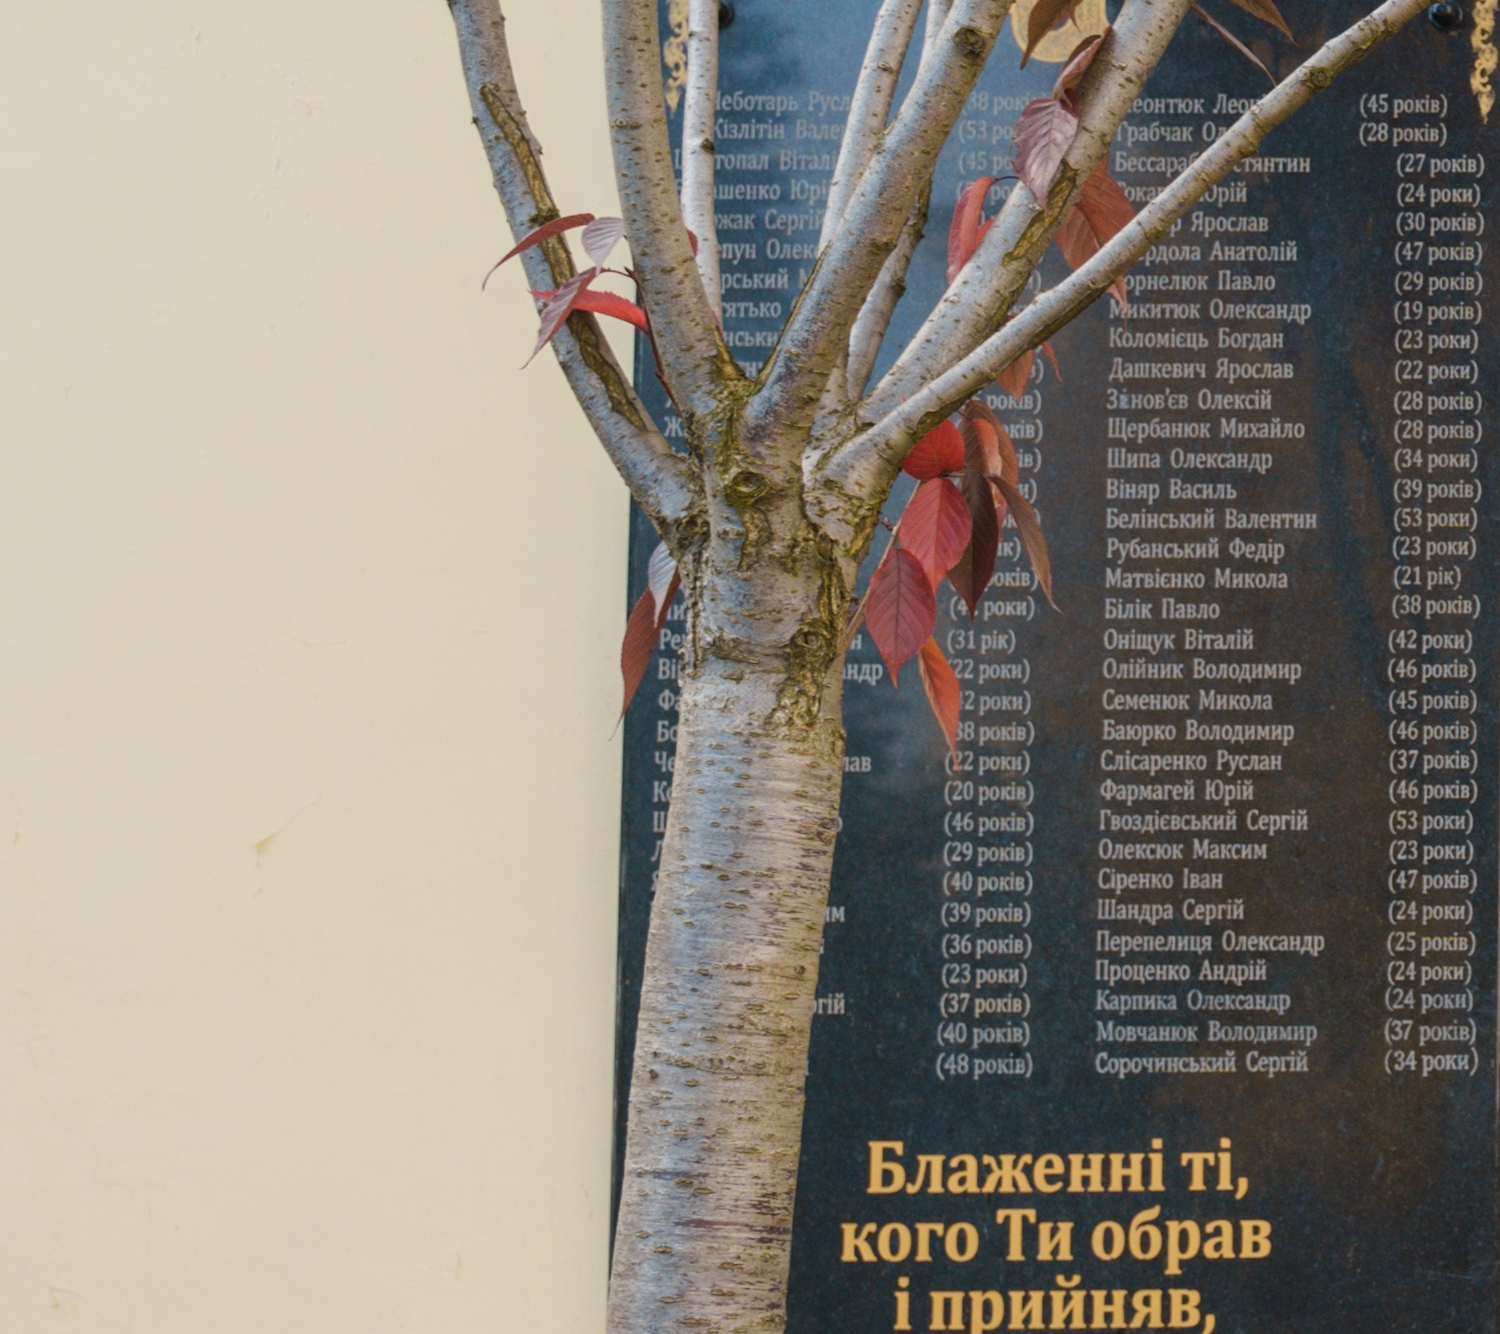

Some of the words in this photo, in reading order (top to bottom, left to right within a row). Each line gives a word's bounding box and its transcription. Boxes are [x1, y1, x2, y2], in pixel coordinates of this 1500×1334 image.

[1109, 327, 1208, 352] Коломієць
[1217, 327, 1283, 352] Богдан
[1393, 329, 1423, 352] (23
[1427, 330, 1478, 353] роки)
[1107, 447, 1160, 468] Шипа
[1170, 447, 1272, 473] Олександр
[1393, 450, 1423, 473] (34
[1427, 450, 1478, 473] роки)
[1105, 478, 1159, 504] Віняр
[1169, 478, 1237, 498] Василь
[1393, 479, 1422, 502] (39
[1427, 479, 1482, 503] років)
[1104, 598, 1151, 619] Білік
[1161, 598, 1220, 619] Павло
[1392, 595, 1421, 619] (38
[1425, 595, 1480, 619] років)
[1102, 688, 1189, 710] Семенюк
[1199, 688, 1272, 710] Микола
[1388, 690, 1417, 714] (45
[1422, 690, 1477, 714] років)
[1098, 838, 1183, 859] Олексюк
[1192, 838, 1266, 859] Максим
[1389, 840, 1417, 863] (23
[1423, 840, 1473, 864] роки)
[1095, 930, 1212, 956] Перепелиця
[1221, 930, 1324, 956] Олександр
[1387, 931, 1416, 954] (25
[1421, 931, 1476, 955] років)
[1095, 958, 1189, 985] Проценко
[1199, 958, 1266, 985] Андрій
[1387, 961, 1415, 984] (24
[1420, 961, 1472, 985] роки)
[865, 1137, 1164, 1194] Блаженні
[1180, 1137, 1249, 1199] ті,
[840, 1221, 979, 1262] кого
[995, 1207, 1074, 1261] Ти
[1091, 1204, 1272, 1274] обрав
[892, 1276, 911, 1331] і
